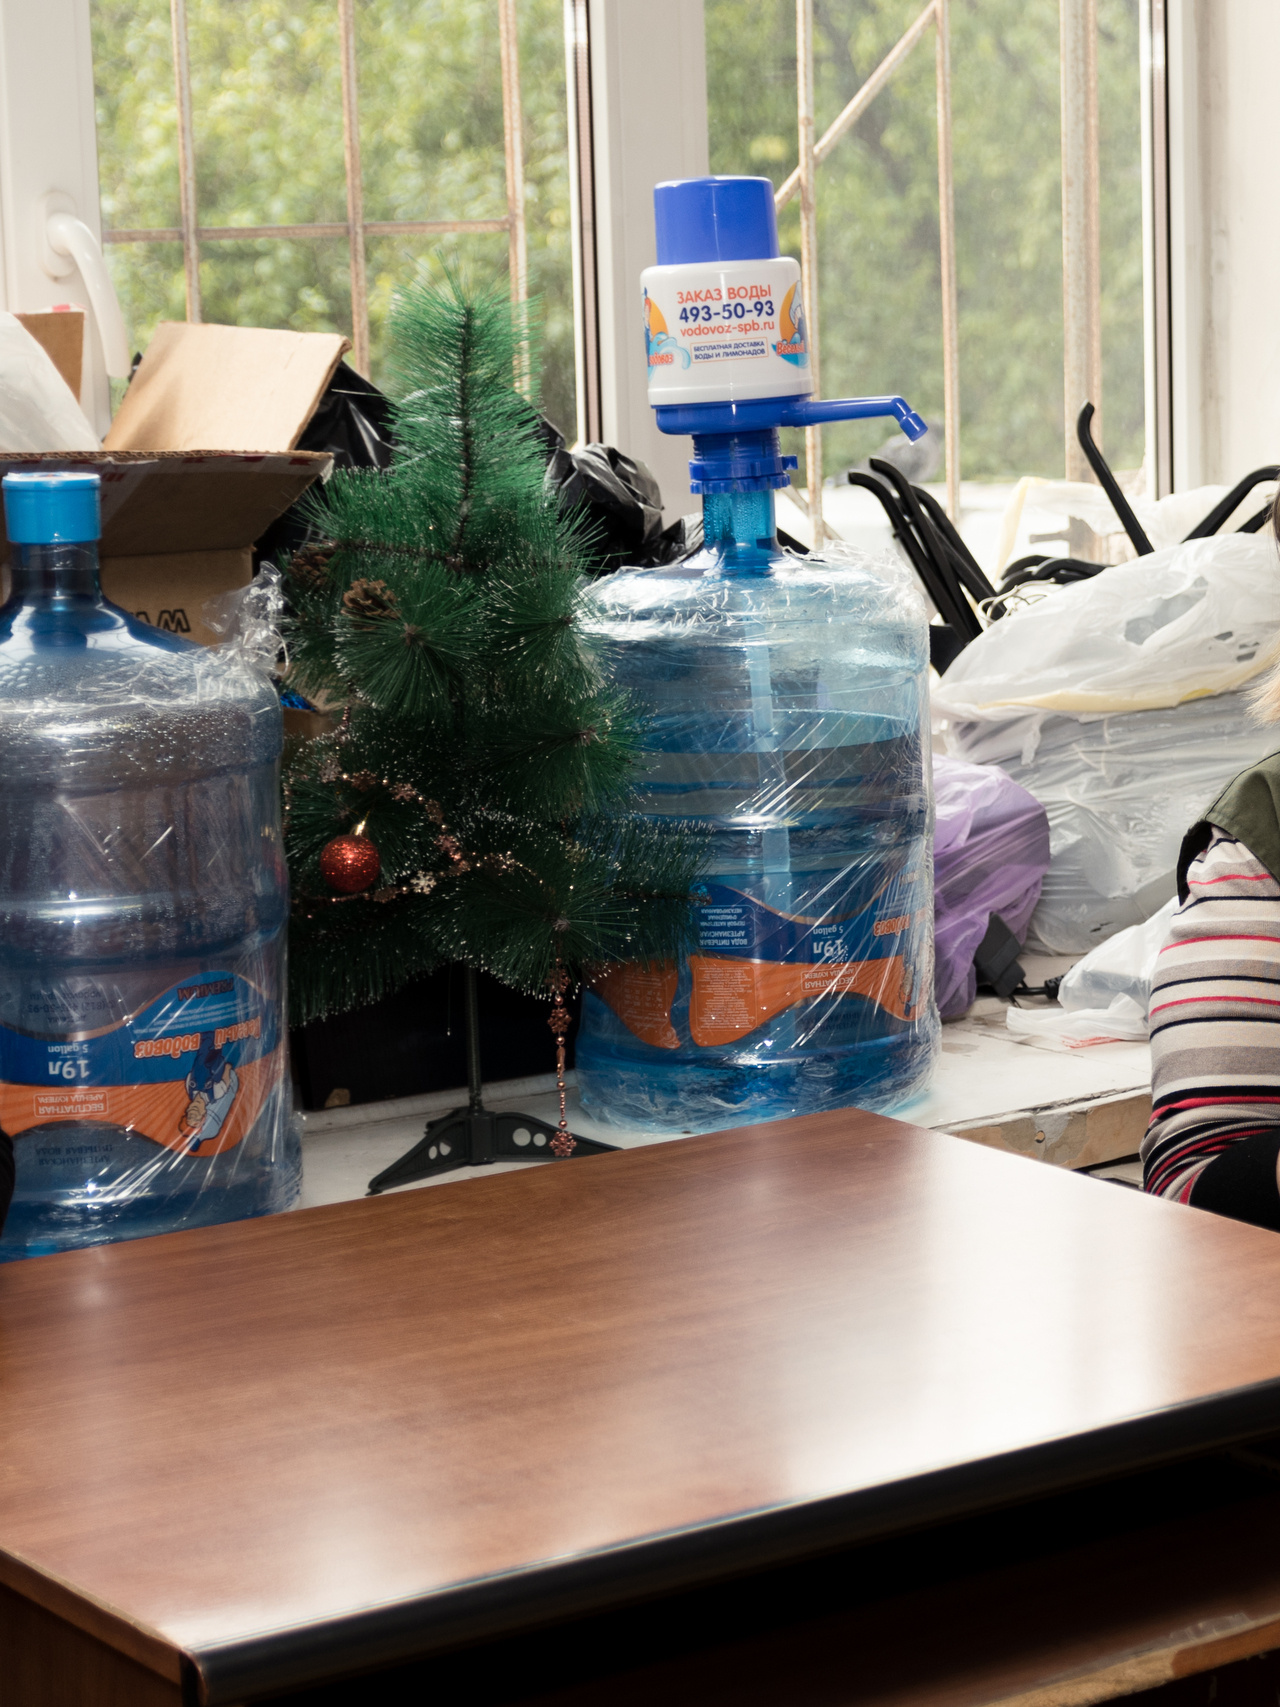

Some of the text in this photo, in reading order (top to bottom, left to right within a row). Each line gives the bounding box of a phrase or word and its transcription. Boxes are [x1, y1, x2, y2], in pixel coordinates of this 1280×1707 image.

[677, 284, 772, 304] ЗАКАЗ ВОДЫ
[679, 300, 775, 323] 493-50-93
[680, 320, 775, 337] vodovoz-spb.ru
[693, 340, 765, 352] БЕСПЛАТНАЯ ДОСТАВКА
[694, 347, 766, 361] ВОДЫ И ЛИМОНАДОВ
[812, 924, 844, 936] 5 gallon
[730, 938, 748, 946] ВОДА
[812, 939, 844, 957] 19л
[178, 978, 234, 1001] PREMIUM
[47, 1042, 88, 1054] 5 gallon
[134, 1033, 200, 1058] водовоз
[48, 1060, 90, 1080] 19л
[37, 1093, 104, 1103] АРЕНДА КУЛЕРА
[38, 1103, 104, 1114] БЕСПЛАТНАЯ
